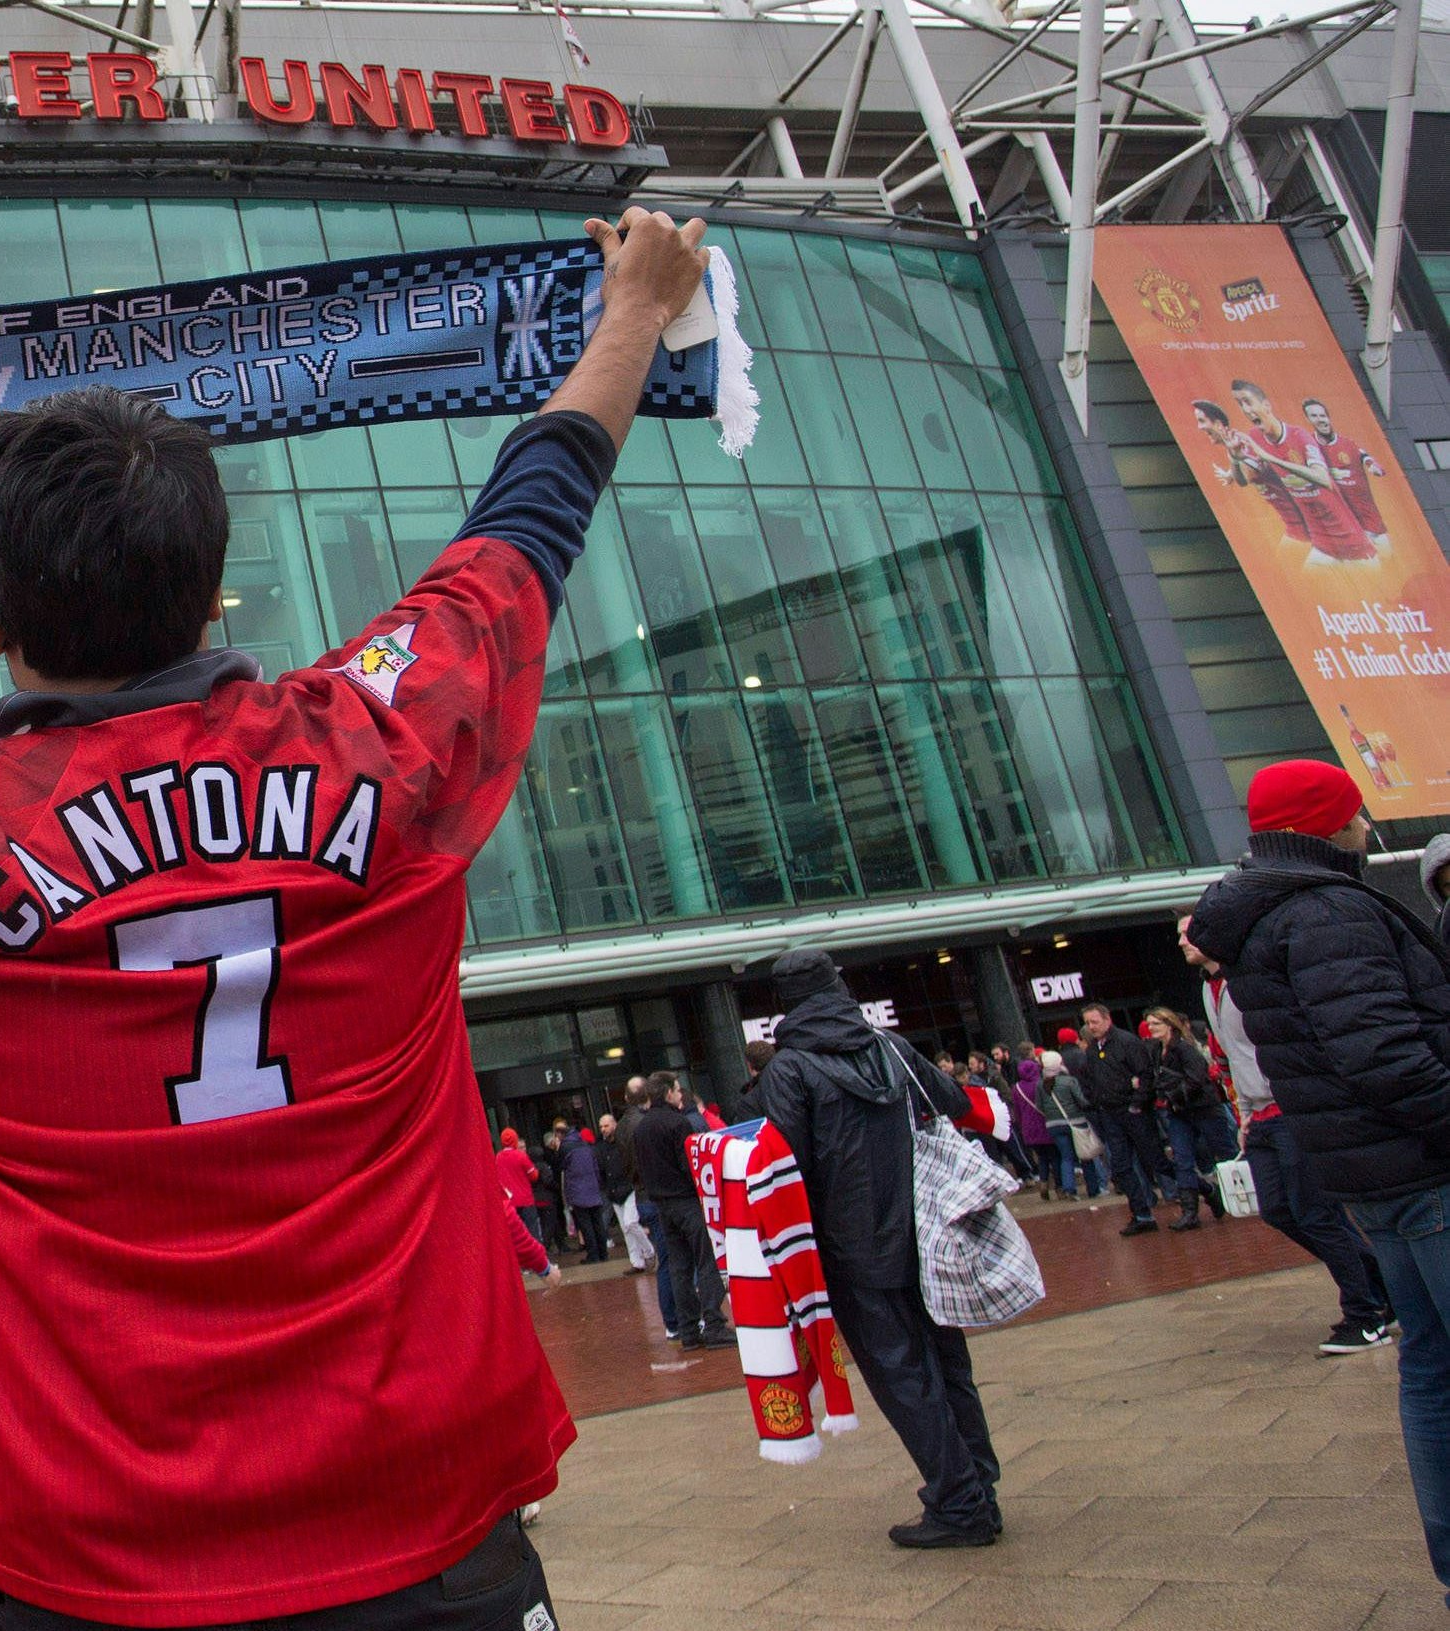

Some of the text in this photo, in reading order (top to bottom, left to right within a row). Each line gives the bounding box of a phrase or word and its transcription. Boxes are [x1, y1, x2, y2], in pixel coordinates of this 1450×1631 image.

[239, 56, 631, 148] UNITED
[56, 276, 310, 327] ENGLAND
[551, 282, 583, 363] CITY
[1221, 292, 1281, 322] Spritz
[22, 282, 486, 379] MANCHESTER
[188, 349, 338, 409] CITY
[1317, 600, 1432, 642] Aperol Spritz
[1313, 647, 1346, 679] #1
[1341, 642, 1407, 678] Italian
[105, 889, 295, 1125] 7
[1031, 972, 1085, 1004] EXIT
